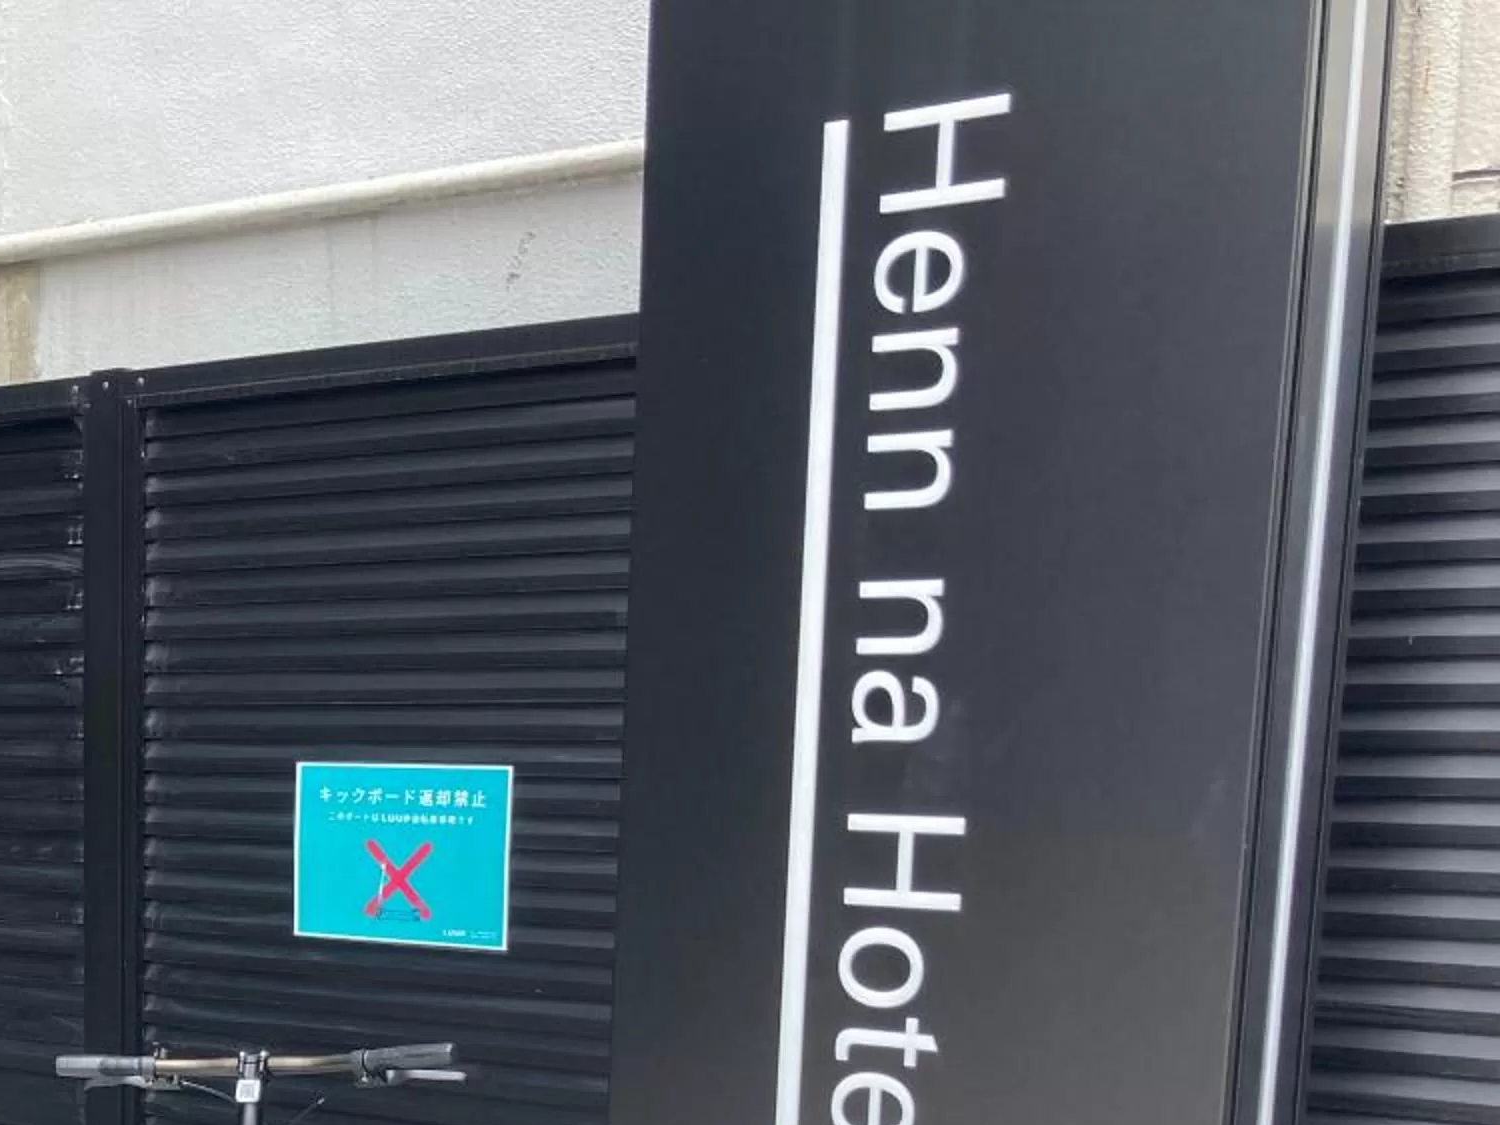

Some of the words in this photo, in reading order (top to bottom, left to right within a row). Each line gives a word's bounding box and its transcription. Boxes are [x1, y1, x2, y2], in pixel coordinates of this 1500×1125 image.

[864, 93, 1011, 510] Henn
[852, 578, 945, 744] na
[319, 786, 487, 808] キックボード返却禁止
